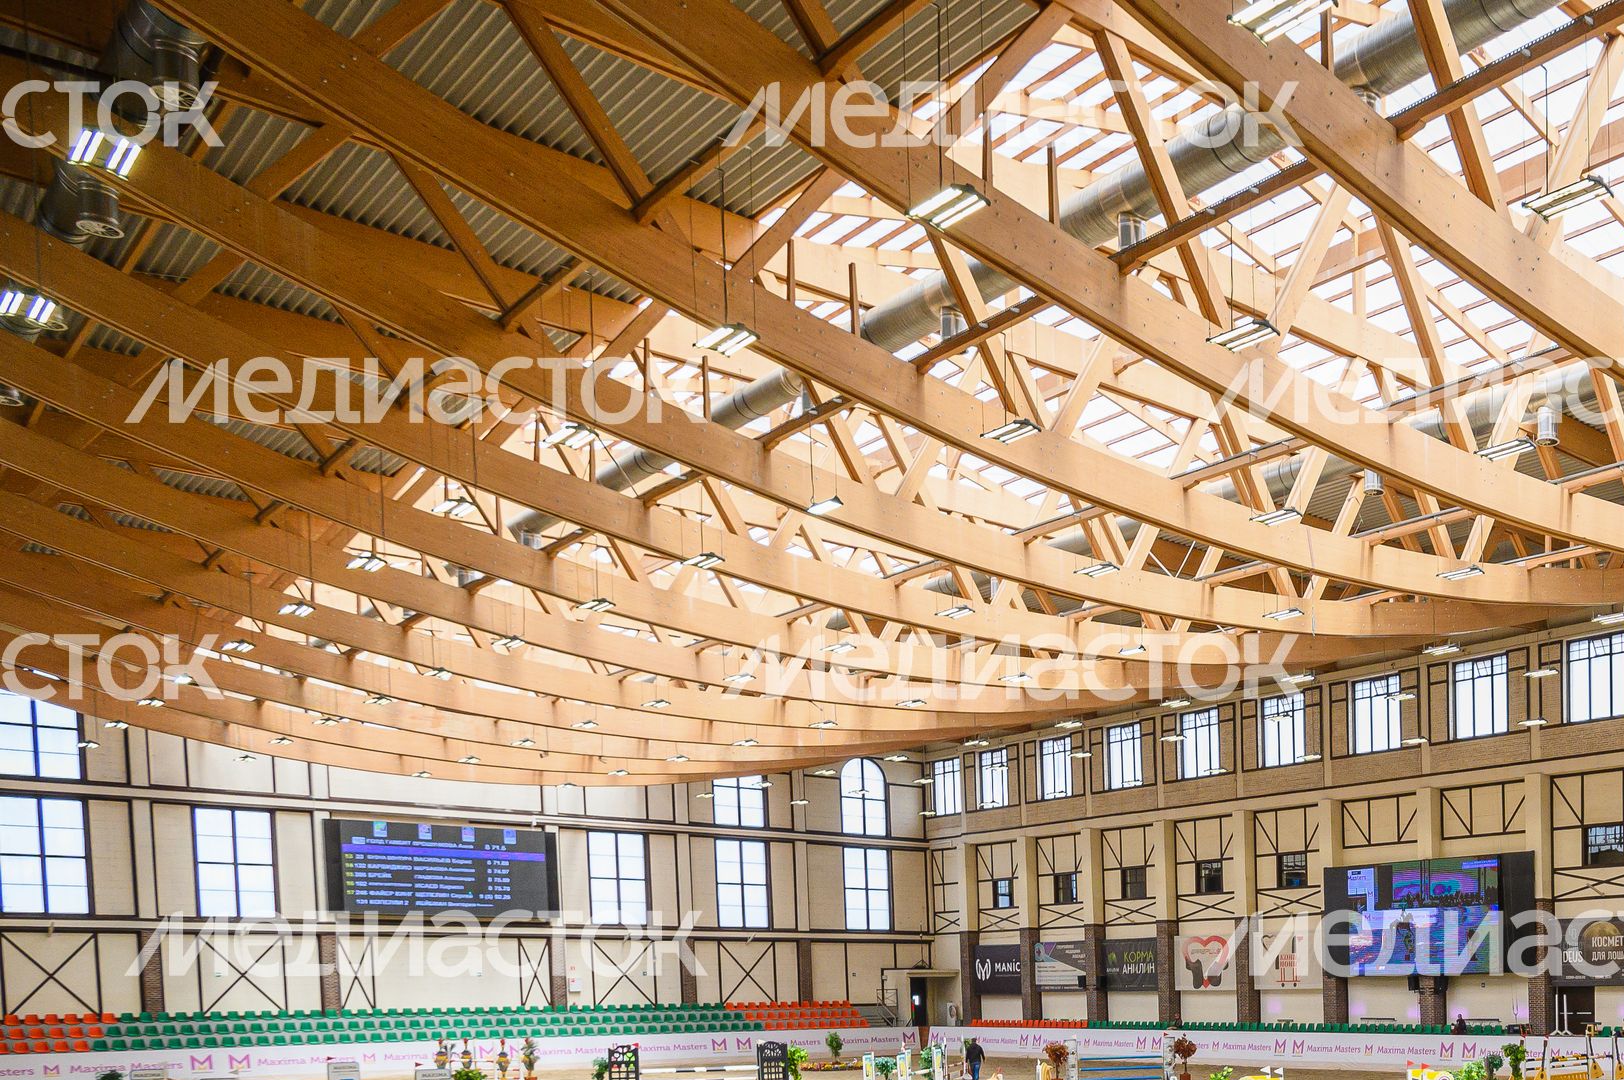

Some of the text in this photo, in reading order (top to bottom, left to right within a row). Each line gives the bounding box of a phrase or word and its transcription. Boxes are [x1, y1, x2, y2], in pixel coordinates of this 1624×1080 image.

[1124, 950, 1154, 963] КОРМА
[1563, 951, 1584, 962] DEUS
[1591, 951, 1606, 962] ДЛЯ
[1122, 963, 1155, 975] АНИЛИН
[1222, 1042, 1271, 1052] Maxima Masters
[1306, 1044, 1361, 1054] Maxima Masters
[1377, 1046, 1436, 1055] Maxima Masters
